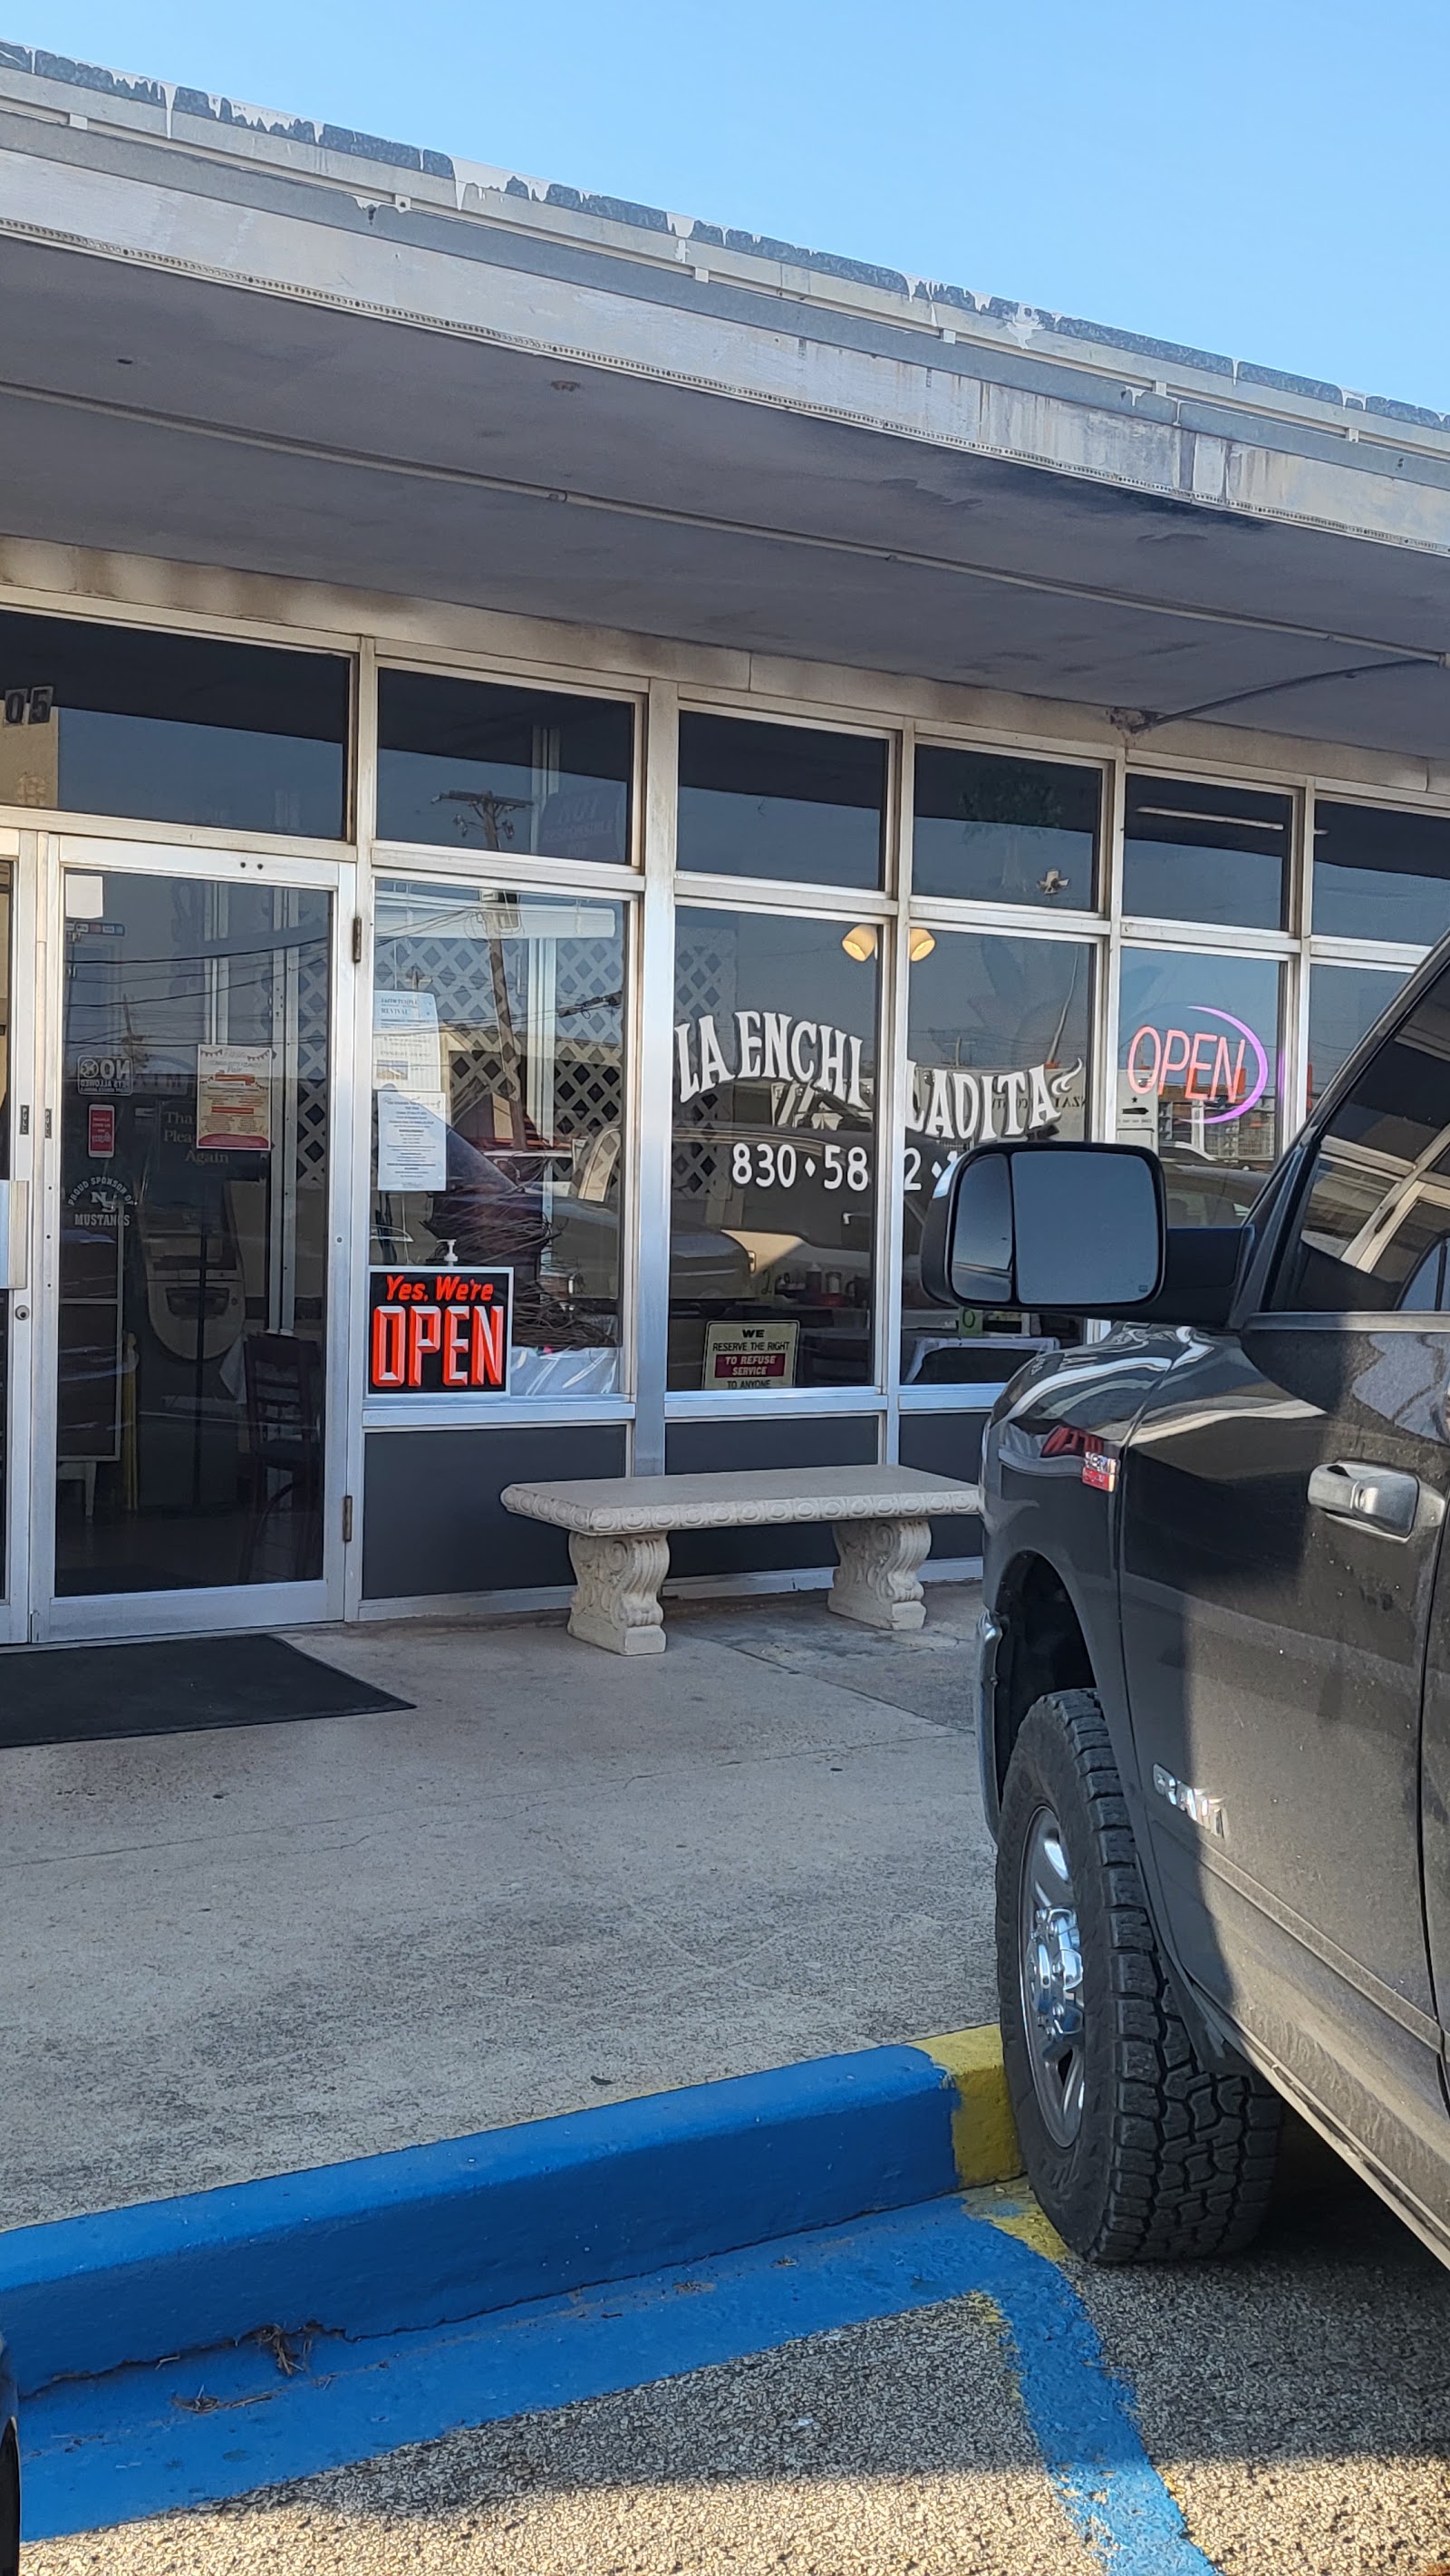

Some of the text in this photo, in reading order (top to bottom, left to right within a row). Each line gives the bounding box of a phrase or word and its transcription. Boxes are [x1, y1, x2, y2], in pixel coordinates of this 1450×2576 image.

[674, 1014, 736, 1103] LA
[1128, 1025, 1245, 1104] OPEN
[164, 1111, 193, 1125] Tha
[68, 1180, 90, 1206] PROUD
[91, 1177, 127, 1195] SPONSOR
[436, 1275, 494, 1302] We're
[742, 1329, 765, 1338] WE
[372, 1305, 504, 1388] OPEN
[712, 1341, 790, 1351] RESERVE THE RIGHT
[725, 1355, 777, 1365] TO REFUSE
[732, 1366, 768, 1376] SERVICE
[727, 1380, 771, 1389] TO ANYONE
